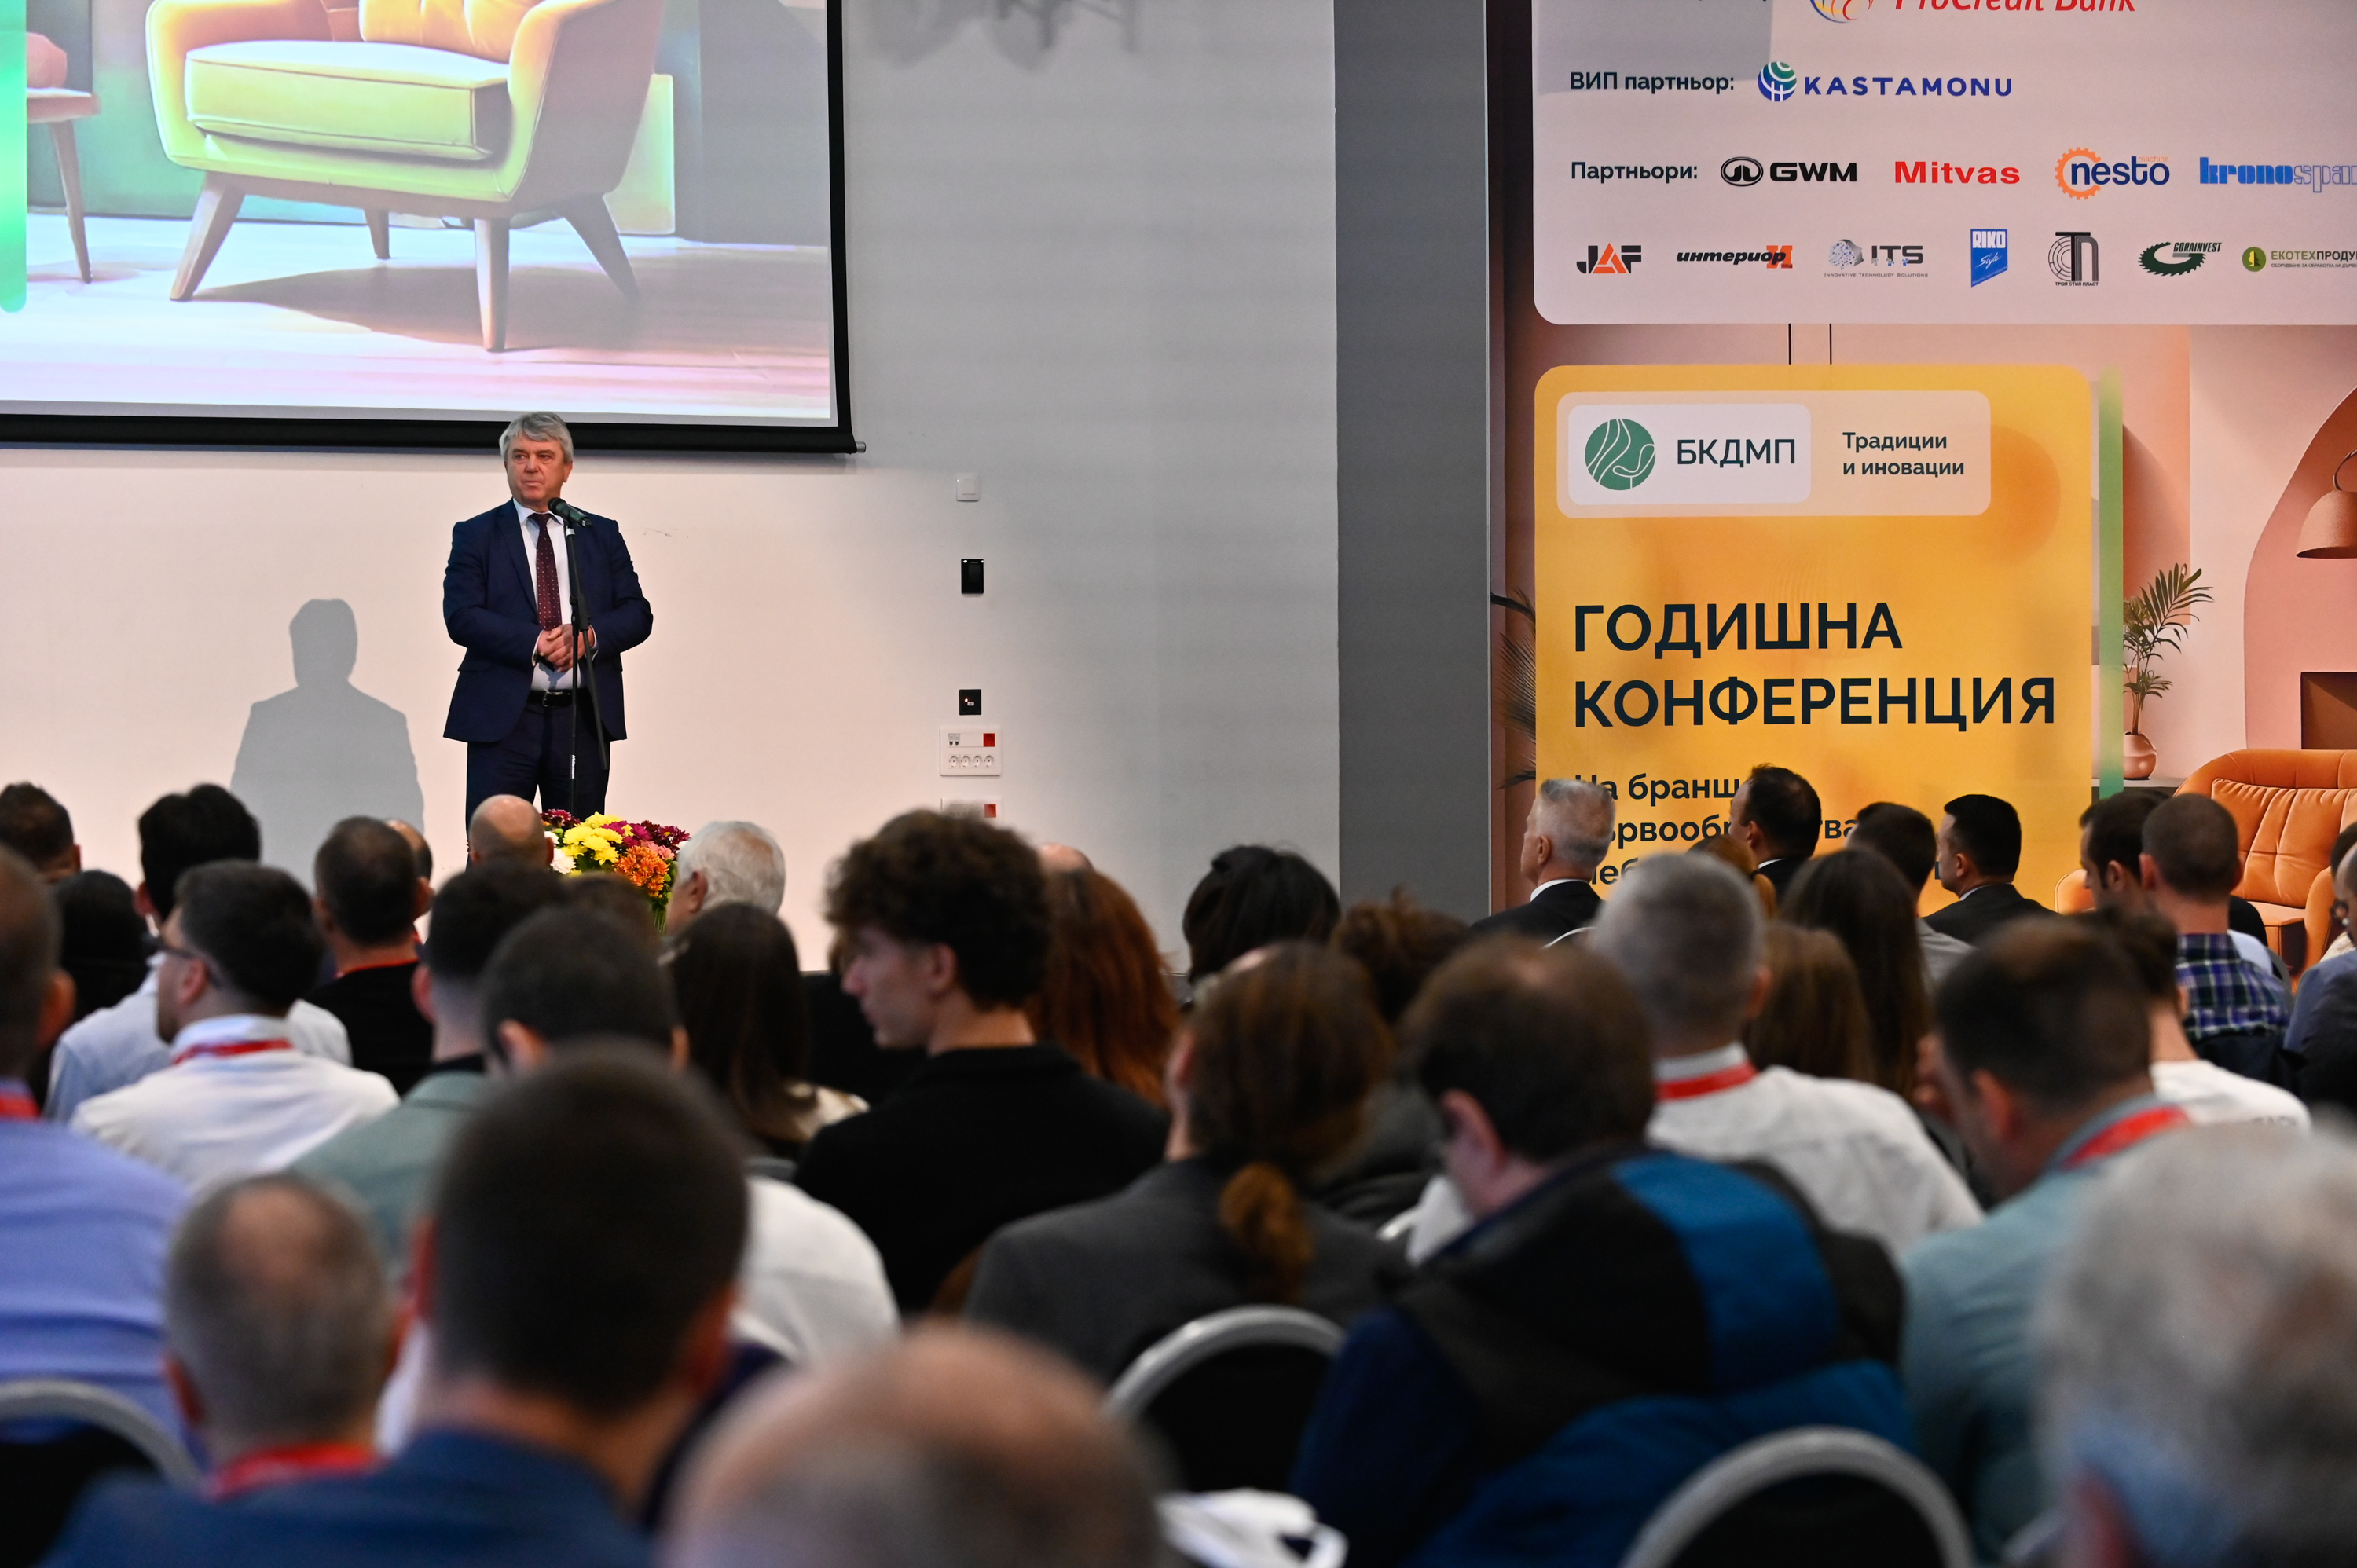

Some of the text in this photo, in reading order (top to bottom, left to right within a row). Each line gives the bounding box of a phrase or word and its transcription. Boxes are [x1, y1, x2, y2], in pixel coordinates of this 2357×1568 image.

[1571, 71, 1734, 95] ВИП партньор:
[1805, 77, 2012, 96] KASTAMONU
[1571, 161, 1698, 185] Партньори:
[1769, 162, 1857, 182] GWM
[1895, 161, 2021, 185] Mitvas
[2071, 156, 2170, 185] nesto
[1972, 230, 2006, 249] RIKO
[2172, 242, 2222, 252] GORAINVEST
[1577, 243, 1641, 273] JAF
[1677, 251, 1786, 265] интериор
[1871, 245, 1923, 265] ITS
[2271, 251, 2357, 262] ЕКОТЕХПРОДУ
[1842, 431, 1948, 452] Традиции
[1677, 438, 1796, 467] БКДМП
[1843, 462, 1965, 478] и иновации
[1574, 602, 1903, 660] ГОДИШНА
[1574, 676, 2055, 732] КОНФЕРЕНЦИЯ
